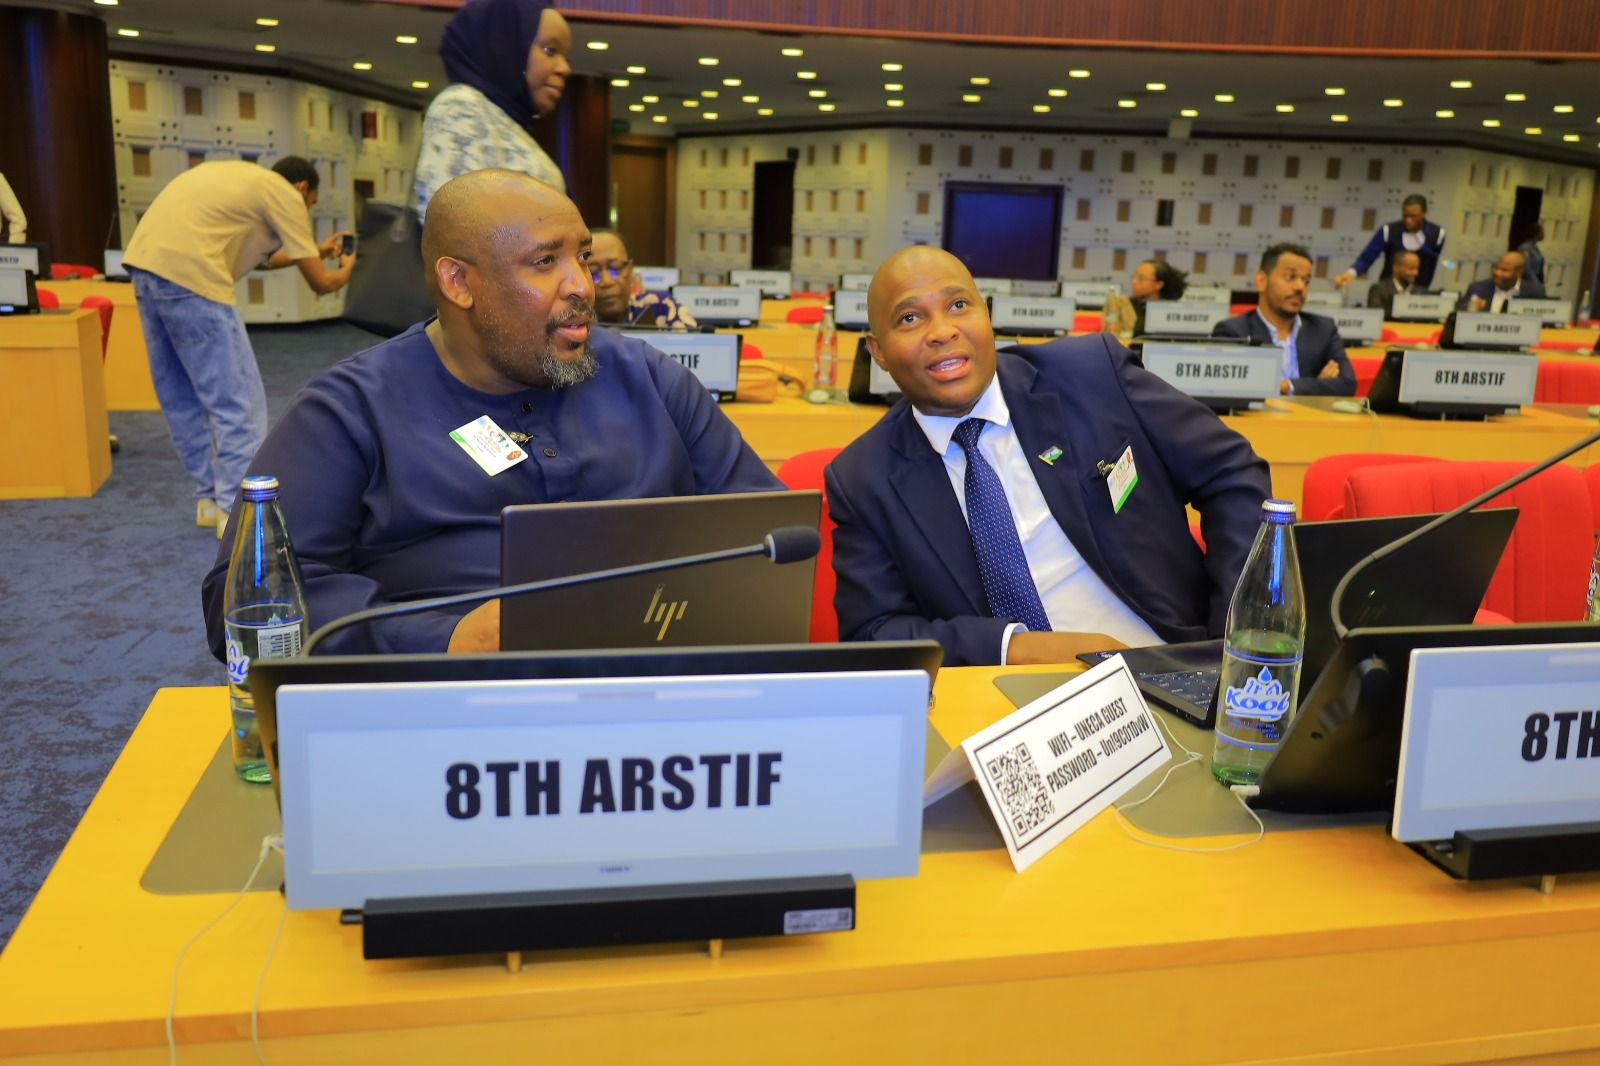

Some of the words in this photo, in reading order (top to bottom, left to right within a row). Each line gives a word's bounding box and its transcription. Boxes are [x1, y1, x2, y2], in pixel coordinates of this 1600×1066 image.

[1175, 363, 1201, 378] 8TH
[1204, 364, 1251, 379] ARSTIF
[1435, 370, 1459, 385] 8TH
[1462, 371, 1506, 386] ARSTIF
[1226, 688, 1290, 711] Kool
[1047, 731, 1073, 758] WIFI
[1074, 711, 1106, 741] UNECA
[1100, 697, 1128, 725] GUEST
[1521, 709, 1600, 762] 8TH
[445, 760, 562, 820] 8TH
[579, 752, 783, 815] ARSTIF
[1046, 748, 1098, 794] PASSWORD
